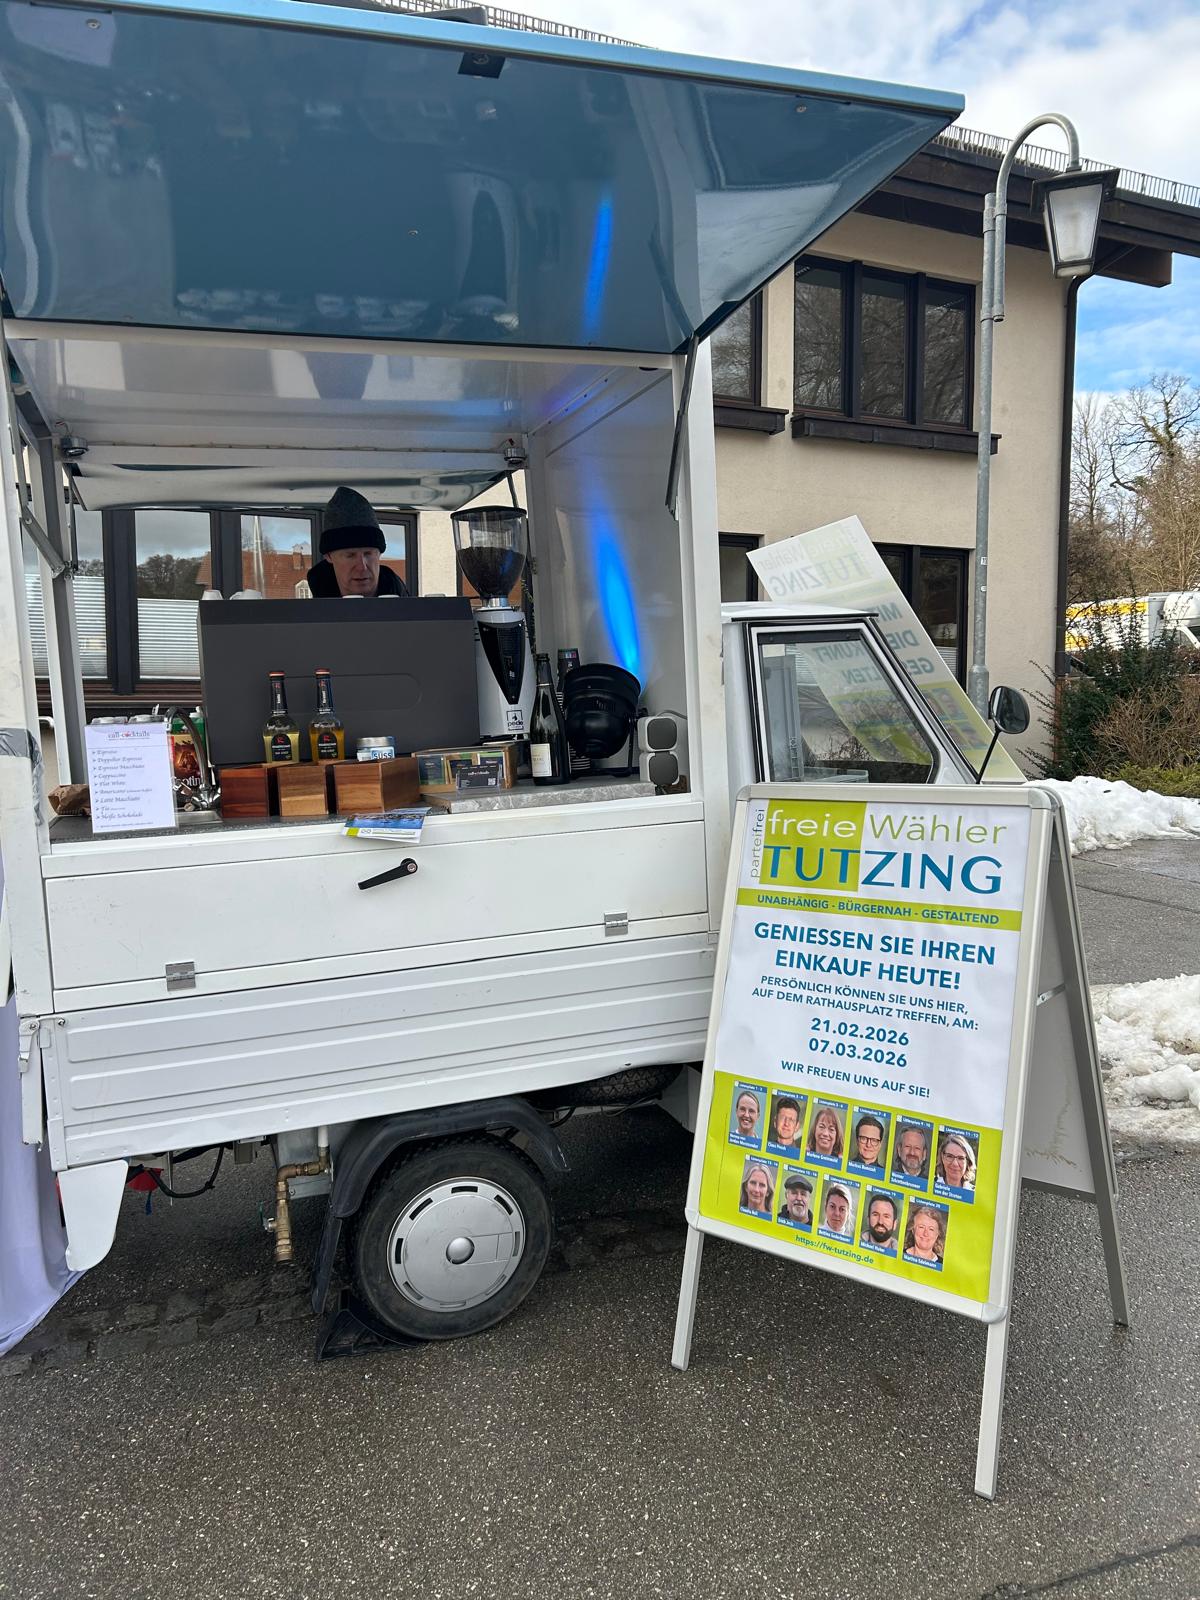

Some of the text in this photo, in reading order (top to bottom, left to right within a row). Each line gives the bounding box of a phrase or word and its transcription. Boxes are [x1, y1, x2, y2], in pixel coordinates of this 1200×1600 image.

[750, 808, 766, 879] parteifrei
[768, 809, 1007, 844] freie Wähler
[764, 845, 1003, 895] TUTZING
[757, 894, 829, 910] UNABHÄNGIG
[838, 900, 912, 917] BÜRGERNAH
[922, 908, 999, 925] GESTALTEND
[754, 922, 996, 965] GENIESSEN SIE IHREN
[776, 950, 961, 990] EINKAUF HEUTE!
[752, 988, 979, 1031] AUF DEM RATHAUSPLATZ TREFFEN, AM:
[761, 975, 969, 1016] PERSÖNLICH KÖNNEN SIE UNS HIER,
[811, 1018, 910, 1046] 21.02.2026
[808, 1038, 907, 1068] 07.03.2026
[781, 1060, 930, 1099] WIR FREUEN UNS AUF SIE!
[795, 1234, 874, 1265] https://fw-tutzing.de
